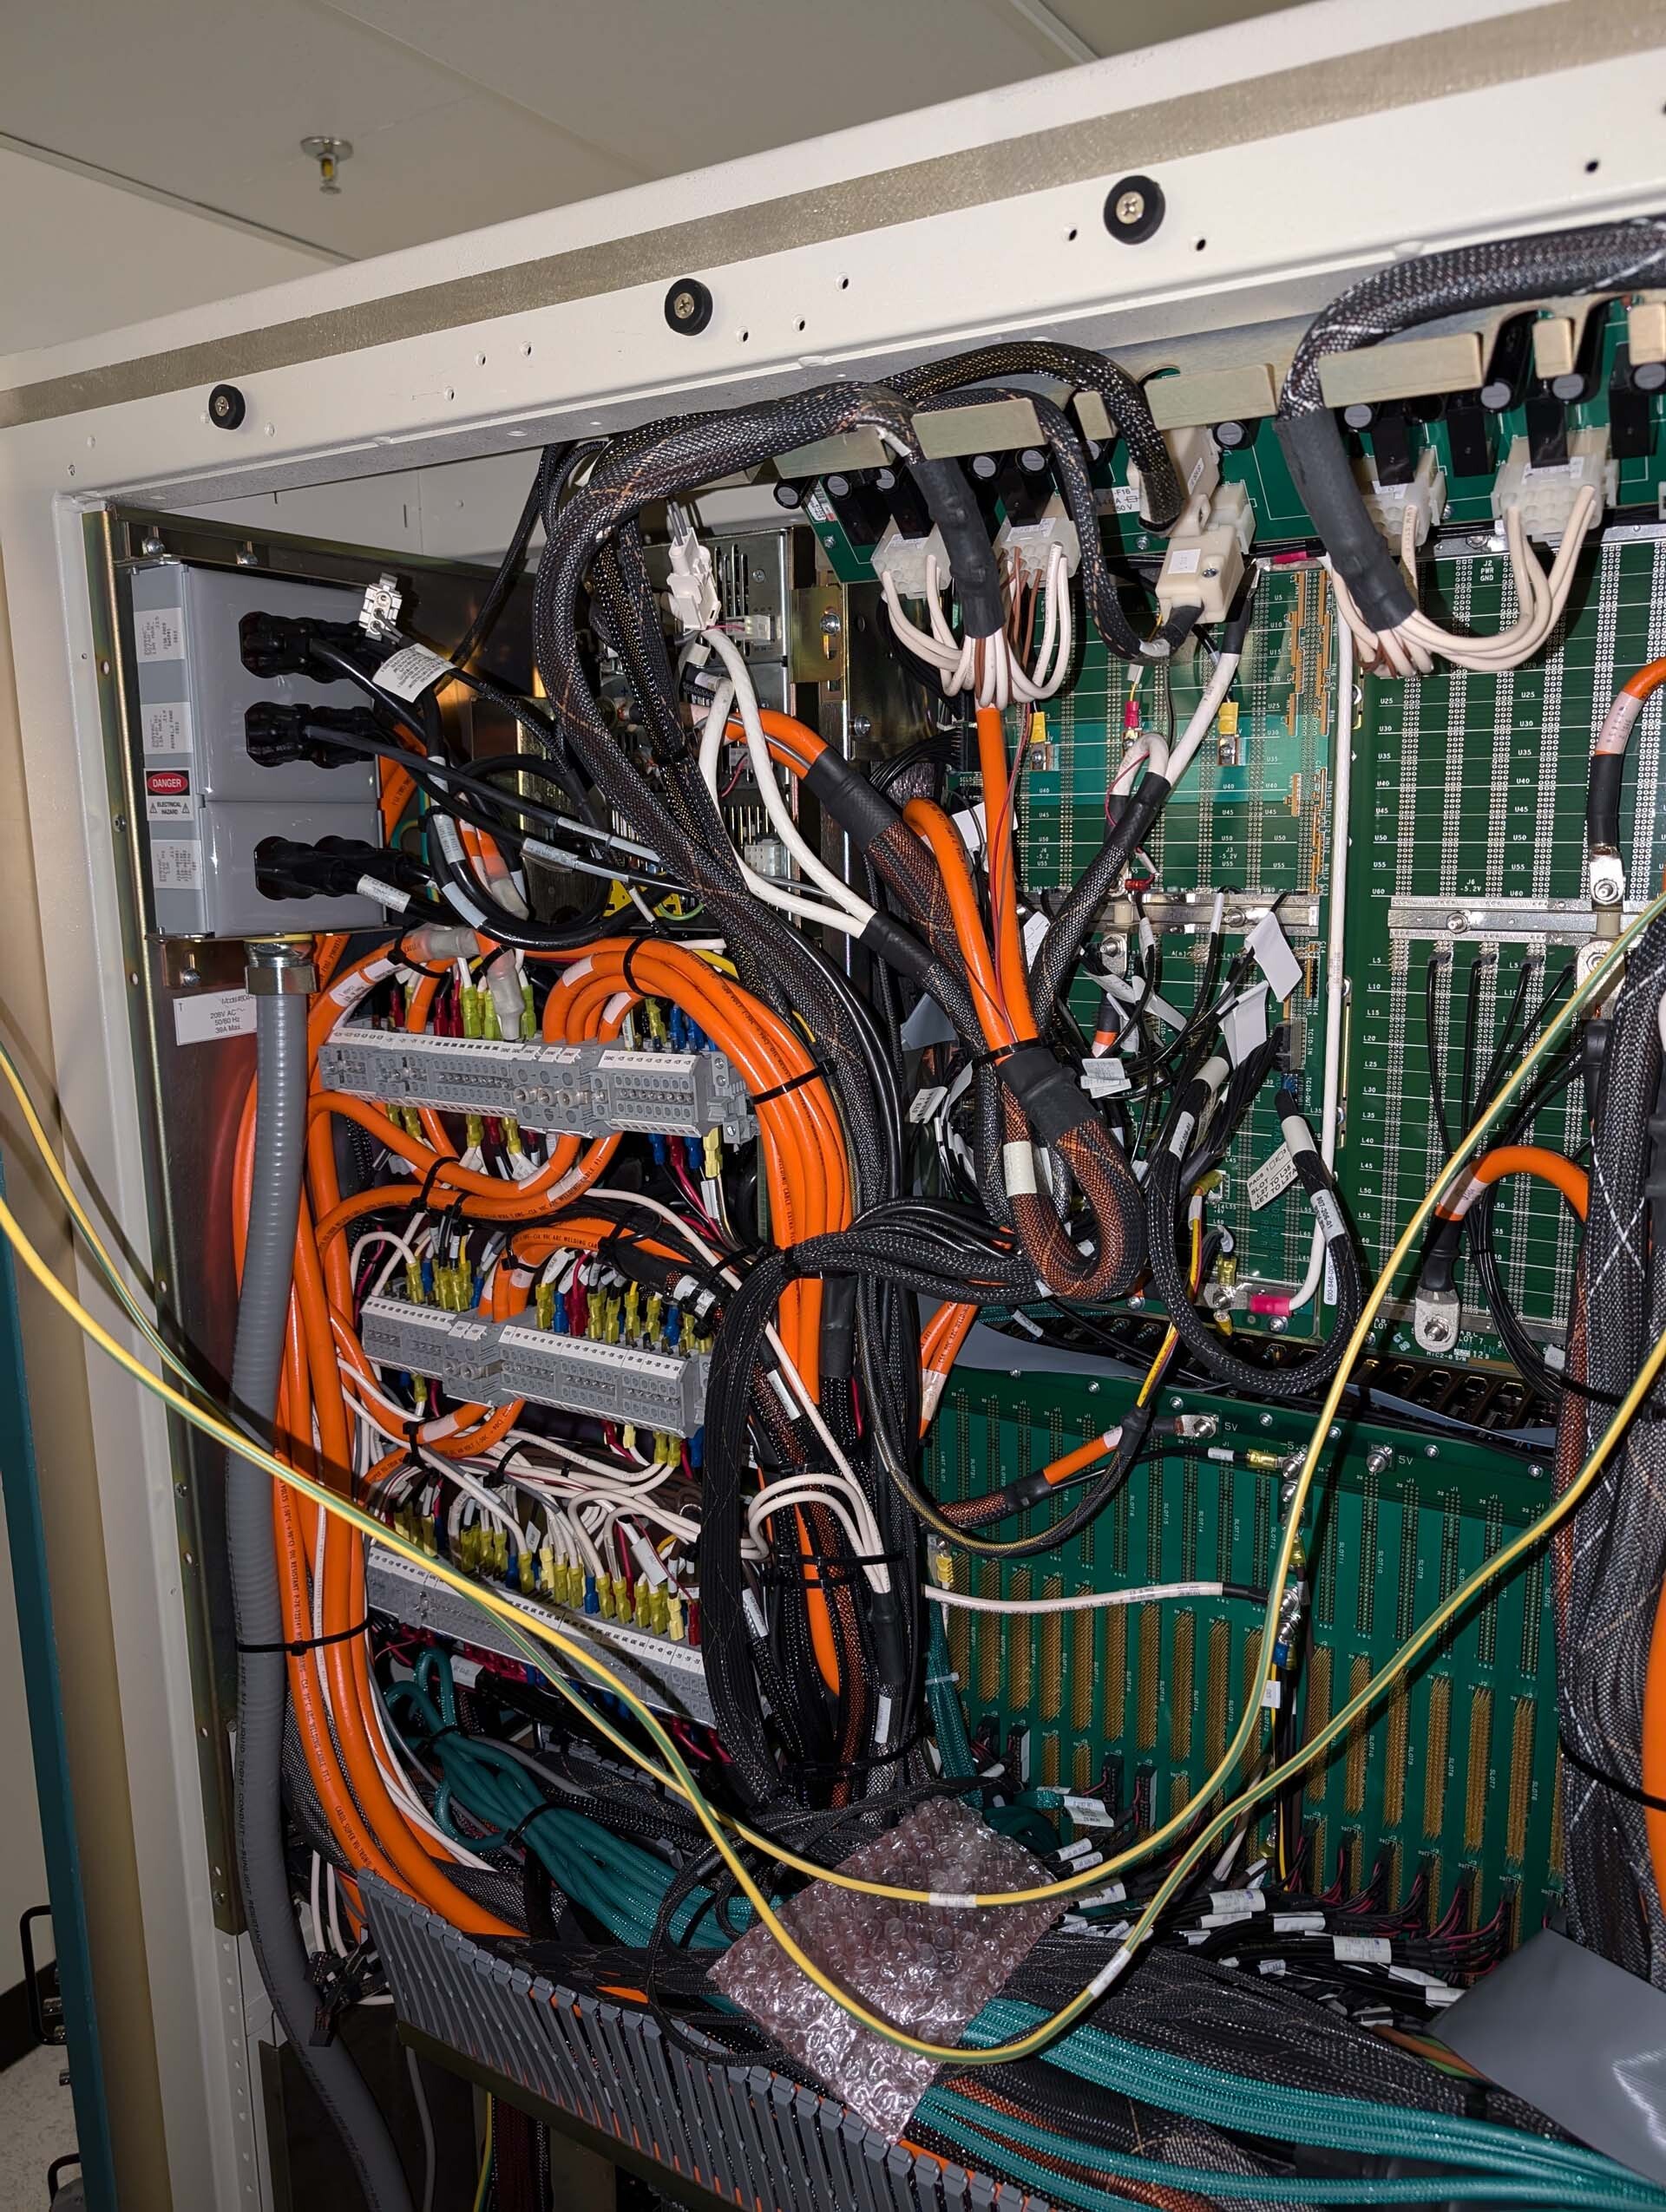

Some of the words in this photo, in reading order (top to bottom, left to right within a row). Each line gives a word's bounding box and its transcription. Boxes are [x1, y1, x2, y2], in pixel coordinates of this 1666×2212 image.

[1521, 690, 1536, 699] U25
[1380, 697, 1394, 705] U25
[152, 778, 181, 789] DANGER
[1514, 805, 1529, 814] U45
[1250, 1178, 1269, 1195] SLOT
[1269, 1176, 1280, 1188] TO
[1255, 1194, 1269, 1207] KEY
[1270, 1184, 1281, 1197] TO
[563, 1237, 588, 1247] WELDING
[1224, 1422, 1238, 1432] 5V
[1398, 1455, 1413, 1465] 5V
